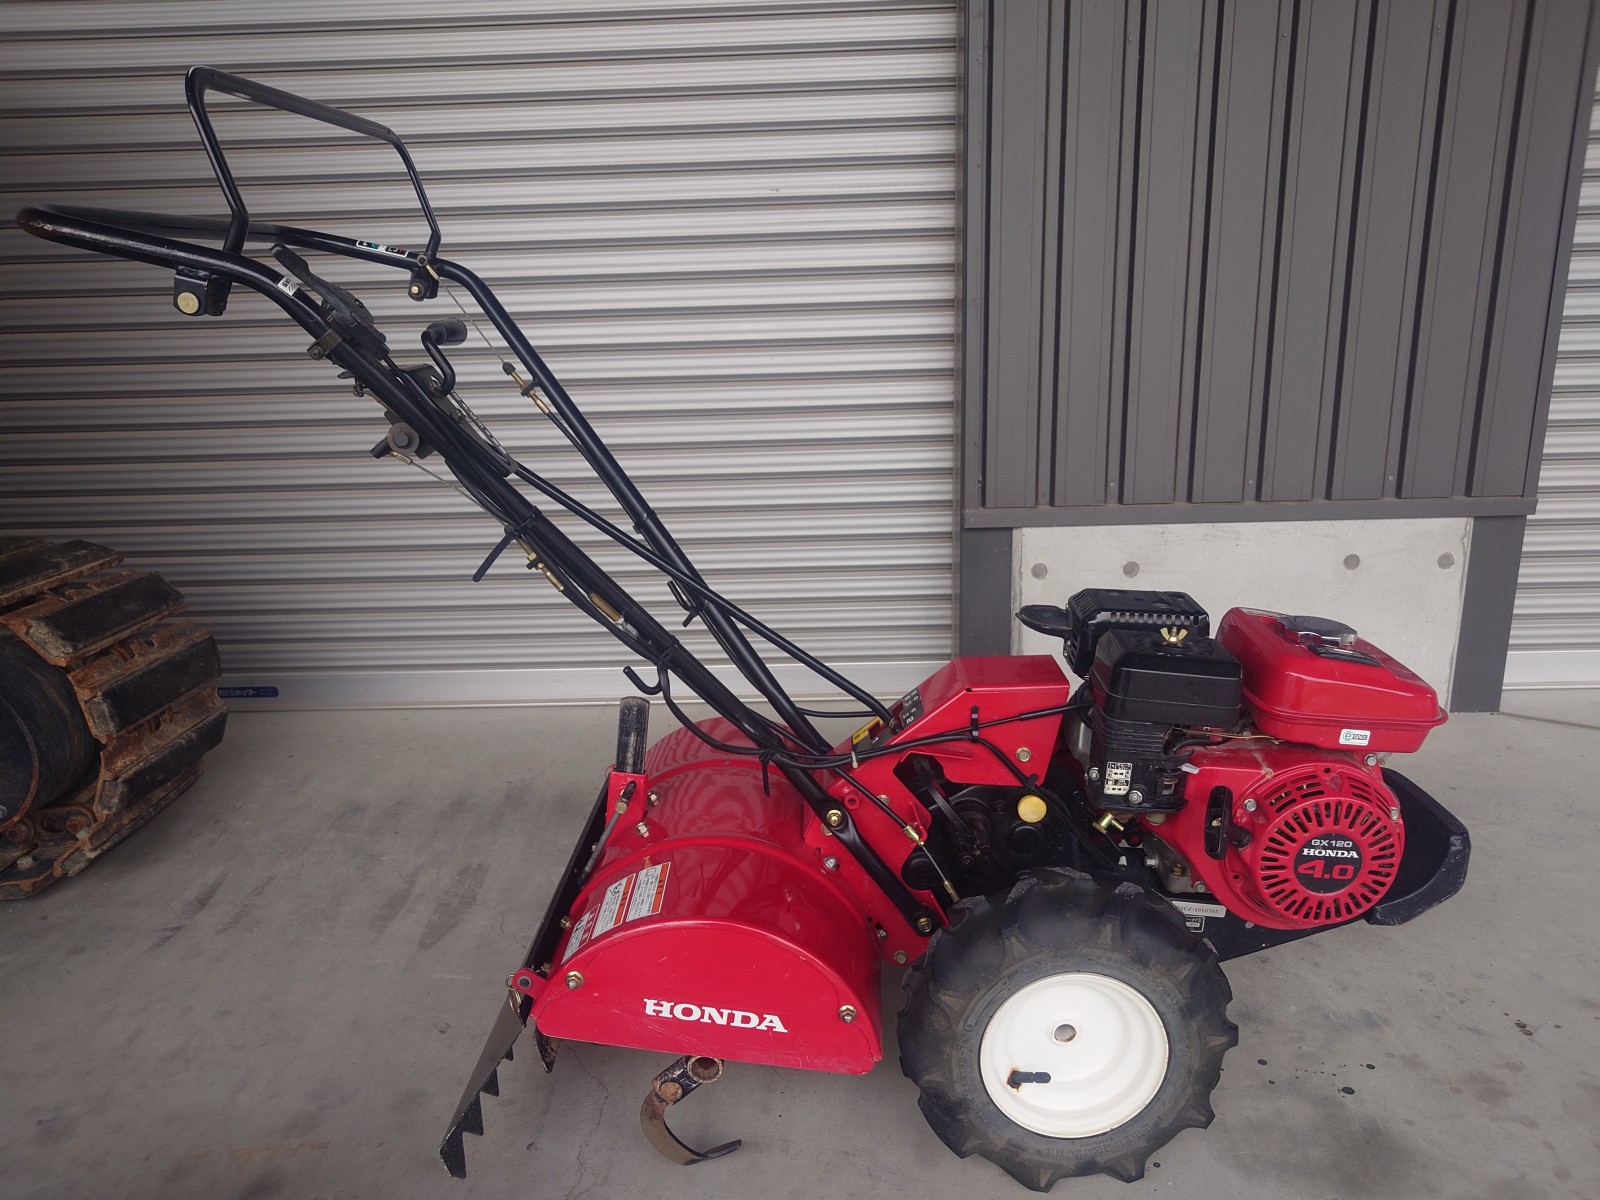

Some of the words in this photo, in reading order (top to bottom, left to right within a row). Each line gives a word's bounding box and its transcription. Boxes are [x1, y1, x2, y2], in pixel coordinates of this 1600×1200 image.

[1302, 848, 1359, 859] HONDA
[1297, 859, 1354, 880] 4.0
[643, 998, 789, 1034] HONDA
